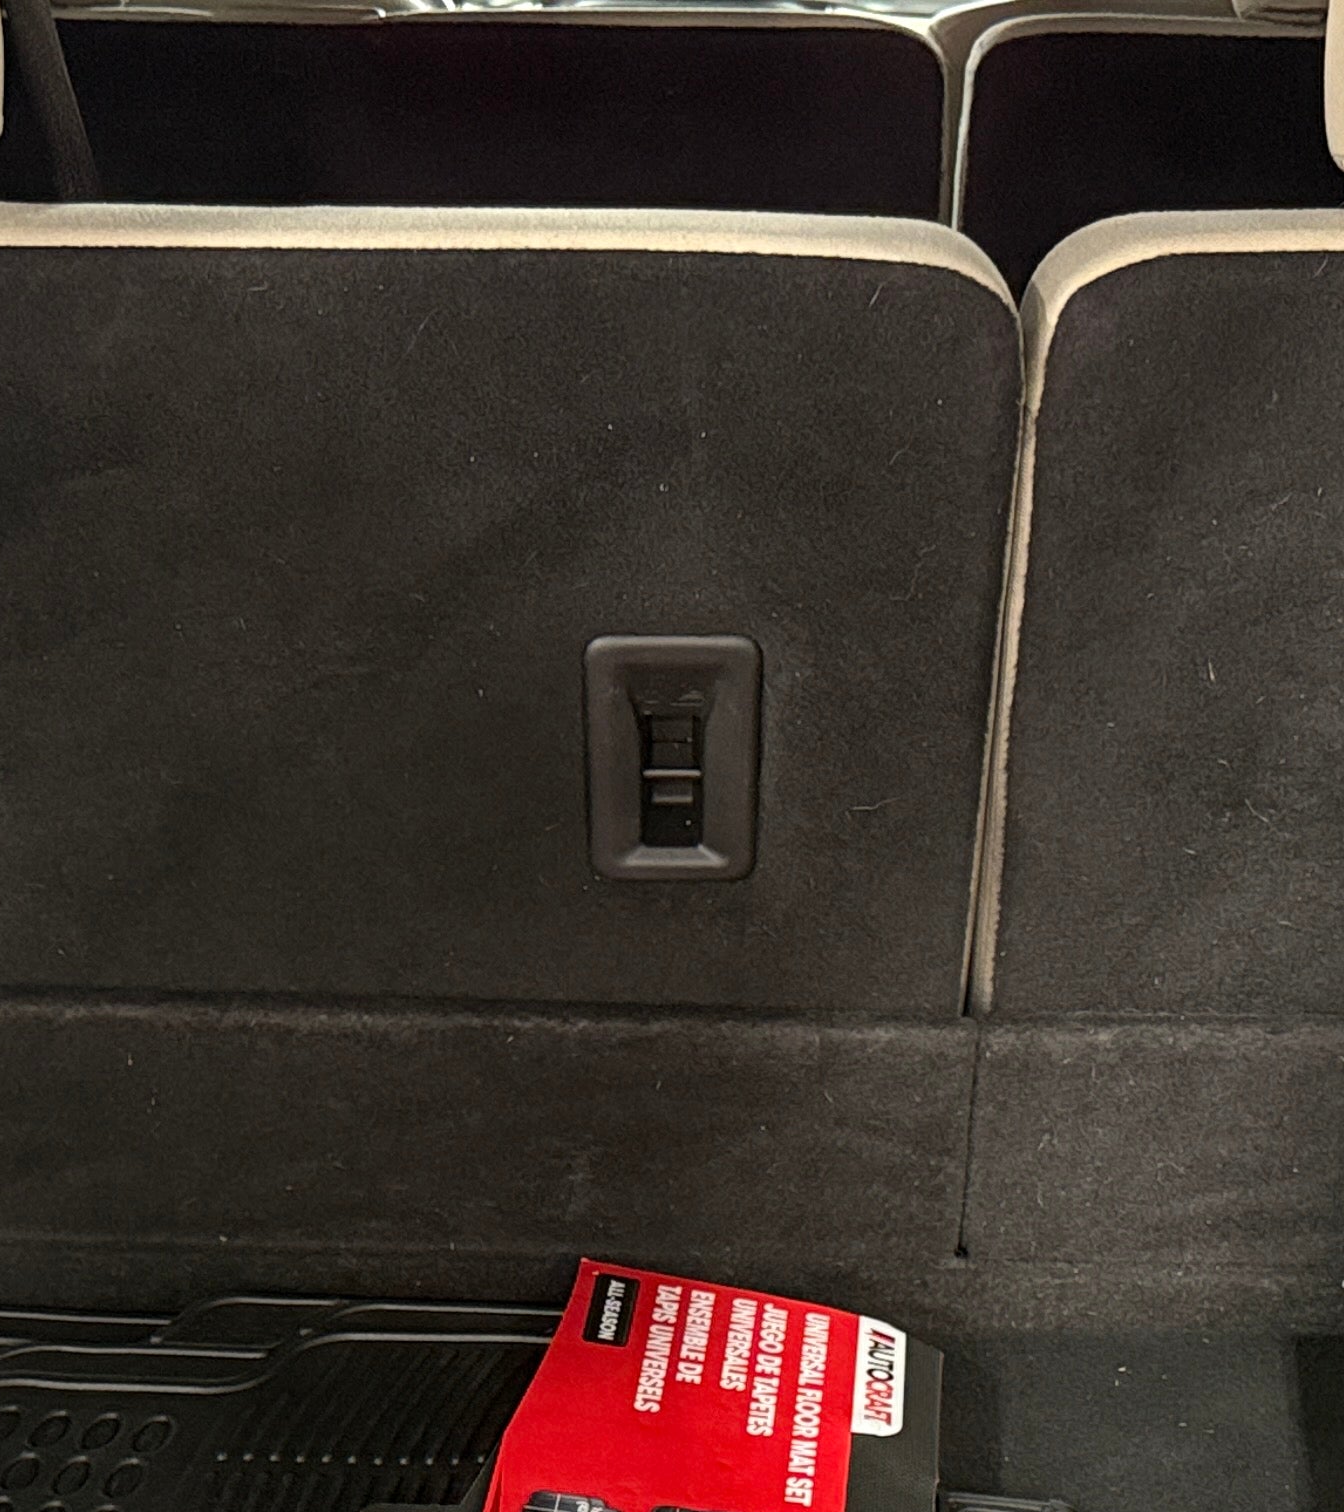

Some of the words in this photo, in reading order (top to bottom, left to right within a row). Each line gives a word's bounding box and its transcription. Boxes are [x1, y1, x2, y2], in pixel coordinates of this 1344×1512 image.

[597, 1280, 626, 1341] ALL-SEASON
[652, 1283, 683, 1324] TAPIS
[679, 1289, 716, 1362] ENSEMBLE
[758, 1303, 789, 1354] JUEGO
[633, 1324, 673, 1414] UNIVERSELS
[675, 1361, 704, 1385] DE
[719, 1298, 758, 1392] UNIVERSALES
[755, 1354, 782, 1375] DE
[798, 1312, 830, 1387] UNIVERSAL
[746, 1376, 780, 1437] TAPETES
[863, 1335, 895, 1427] AUTOCRAFT
[791, 1387, 823, 1438] FLOOR
[787, 1439, 818, 1477] MAT
[784, 1476, 814, 1507] SET
